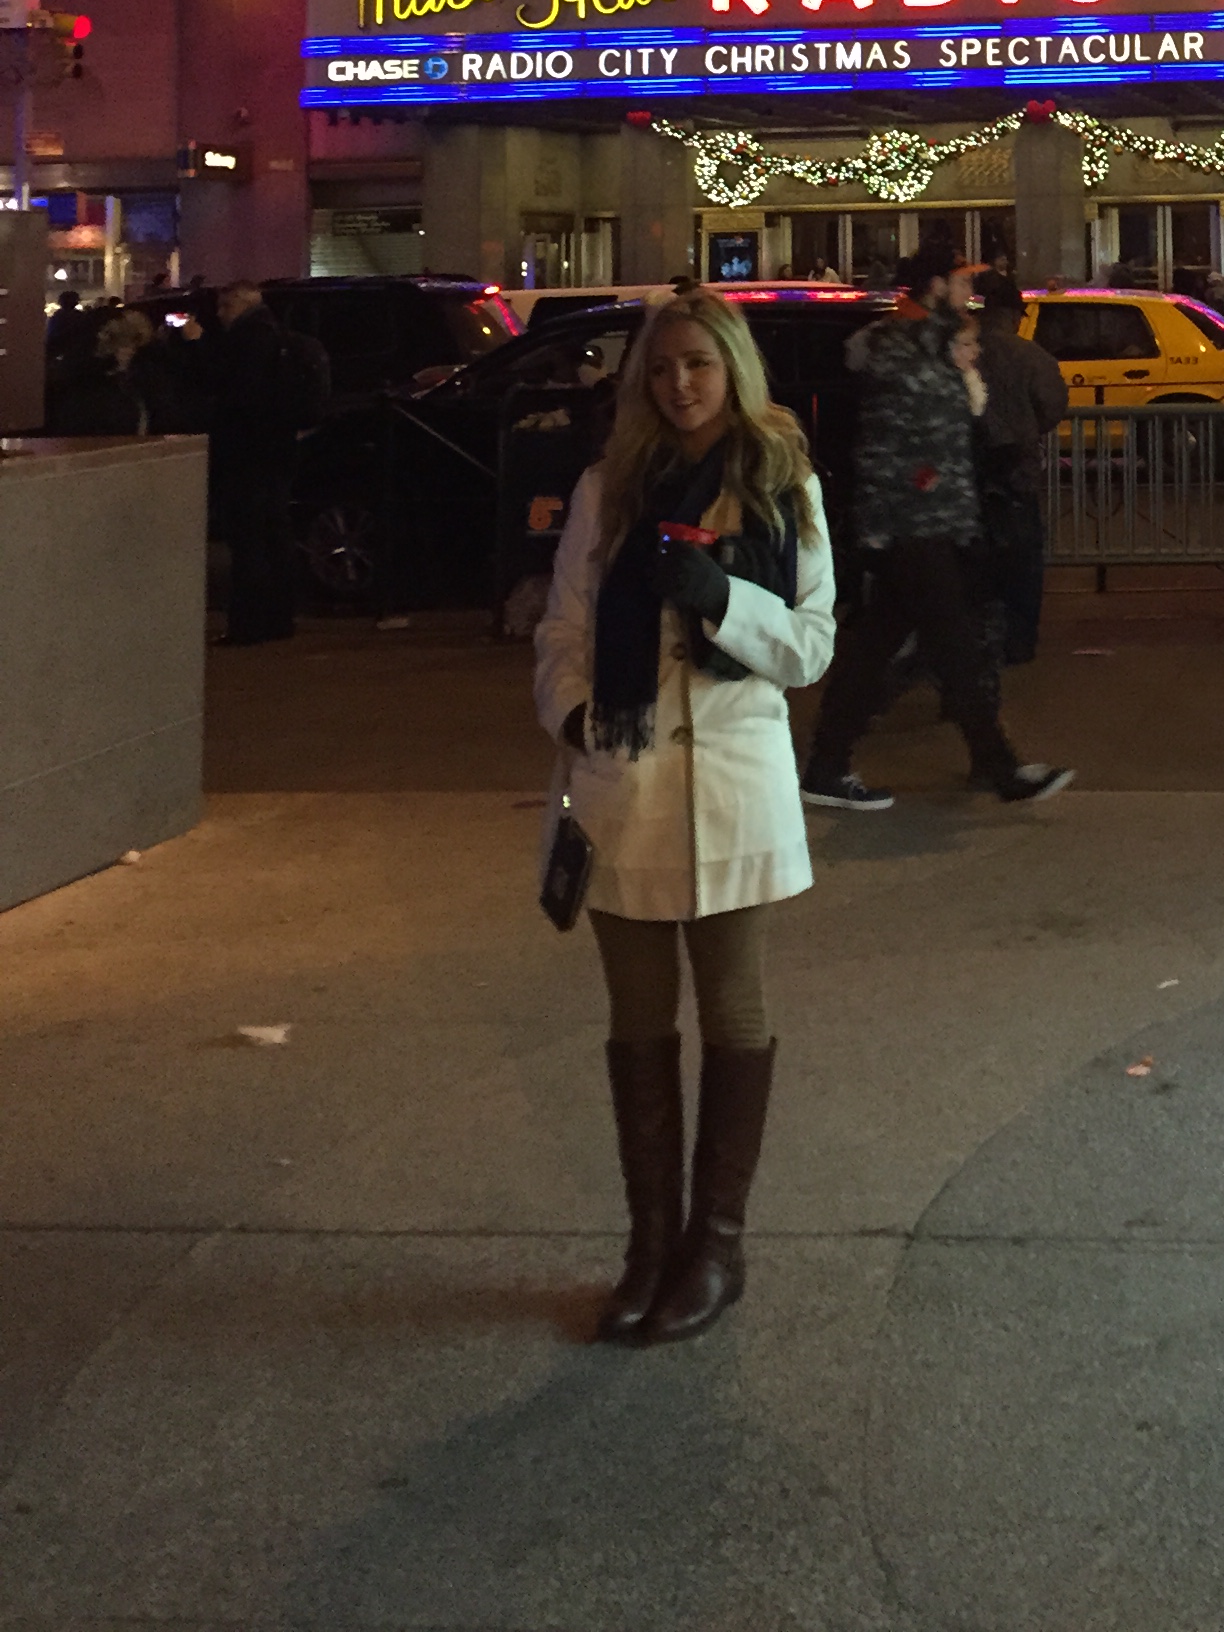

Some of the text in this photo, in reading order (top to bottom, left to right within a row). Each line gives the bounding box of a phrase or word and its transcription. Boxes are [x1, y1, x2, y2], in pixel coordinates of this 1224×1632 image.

[327, 58, 420, 82] CHASE
[462, 51, 574, 80] RADIO
[599, 47, 679, 78] CITY
[704, 39, 911, 74] CHRISTMAS
[938, 30, 1205, 68] SPECTACULAR
